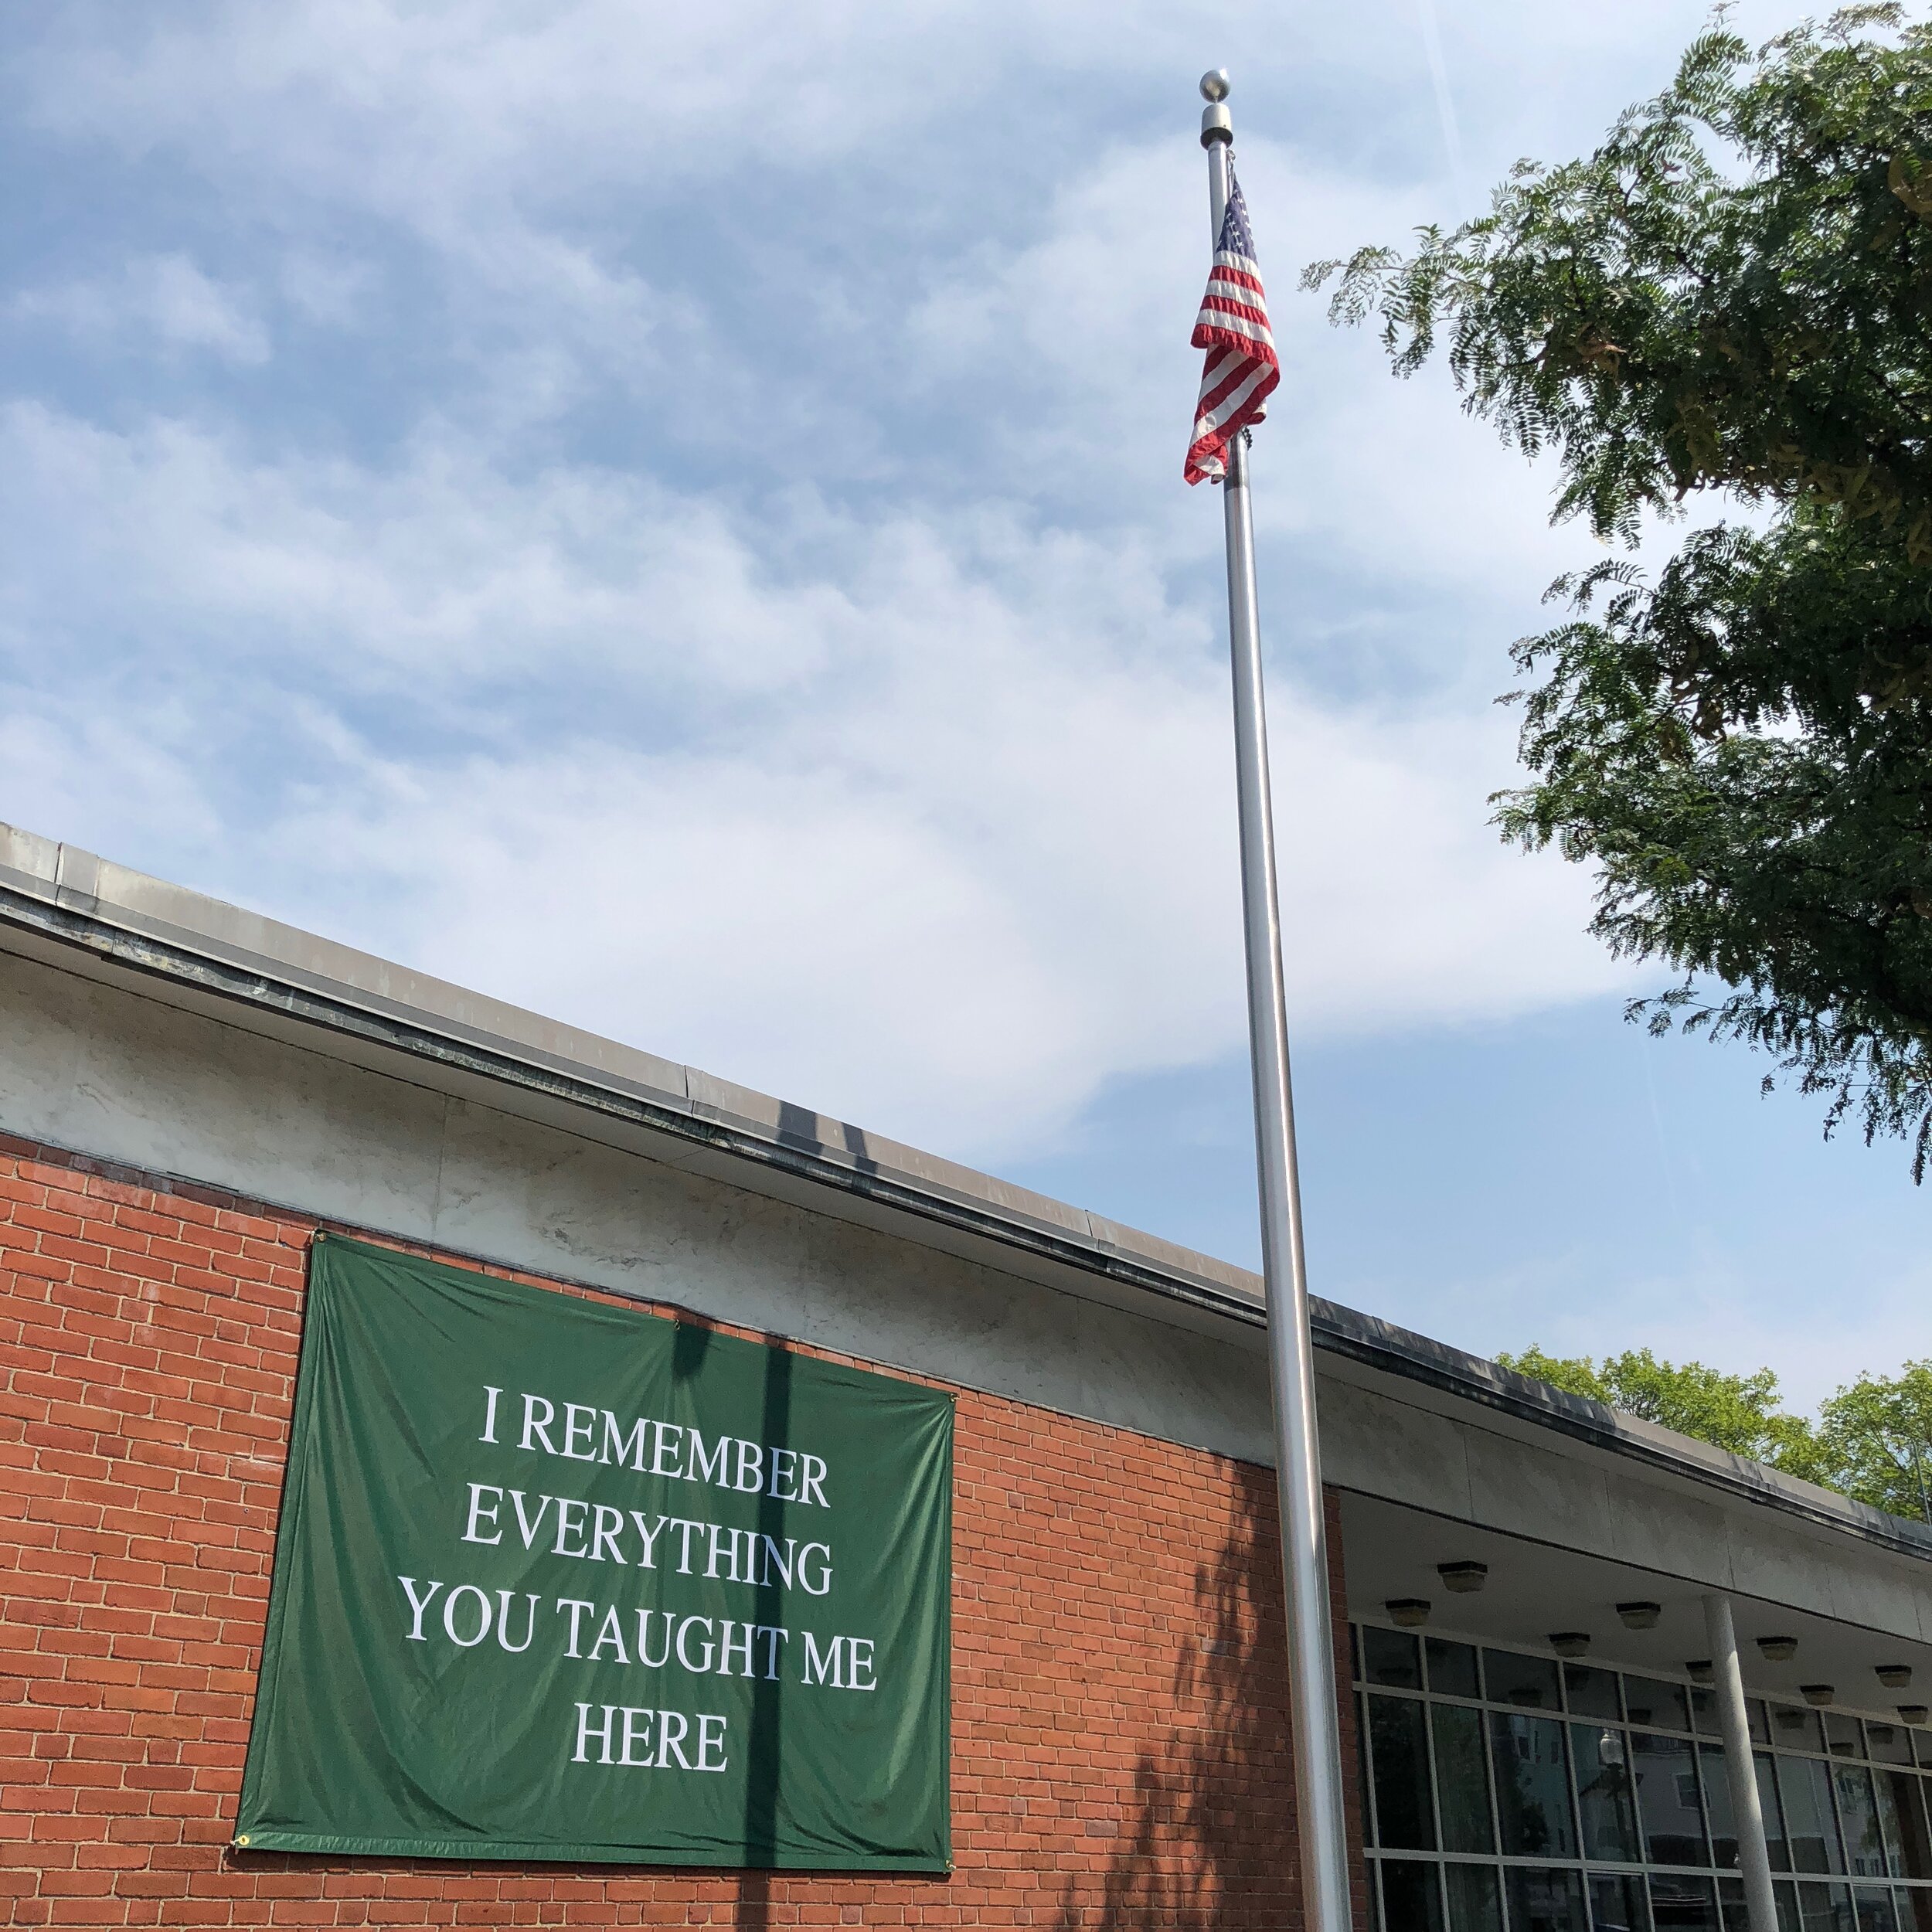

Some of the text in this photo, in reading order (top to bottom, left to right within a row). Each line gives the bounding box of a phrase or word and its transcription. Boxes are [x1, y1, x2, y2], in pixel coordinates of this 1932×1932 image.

[478, 1385, 831, 1509] I REMEMBER
[460, 1482, 834, 1596] EVERYTHING
[397, 1576, 877, 1692] YOU TAUGHT ME
[570, 1702, 729, 1772] HERE
